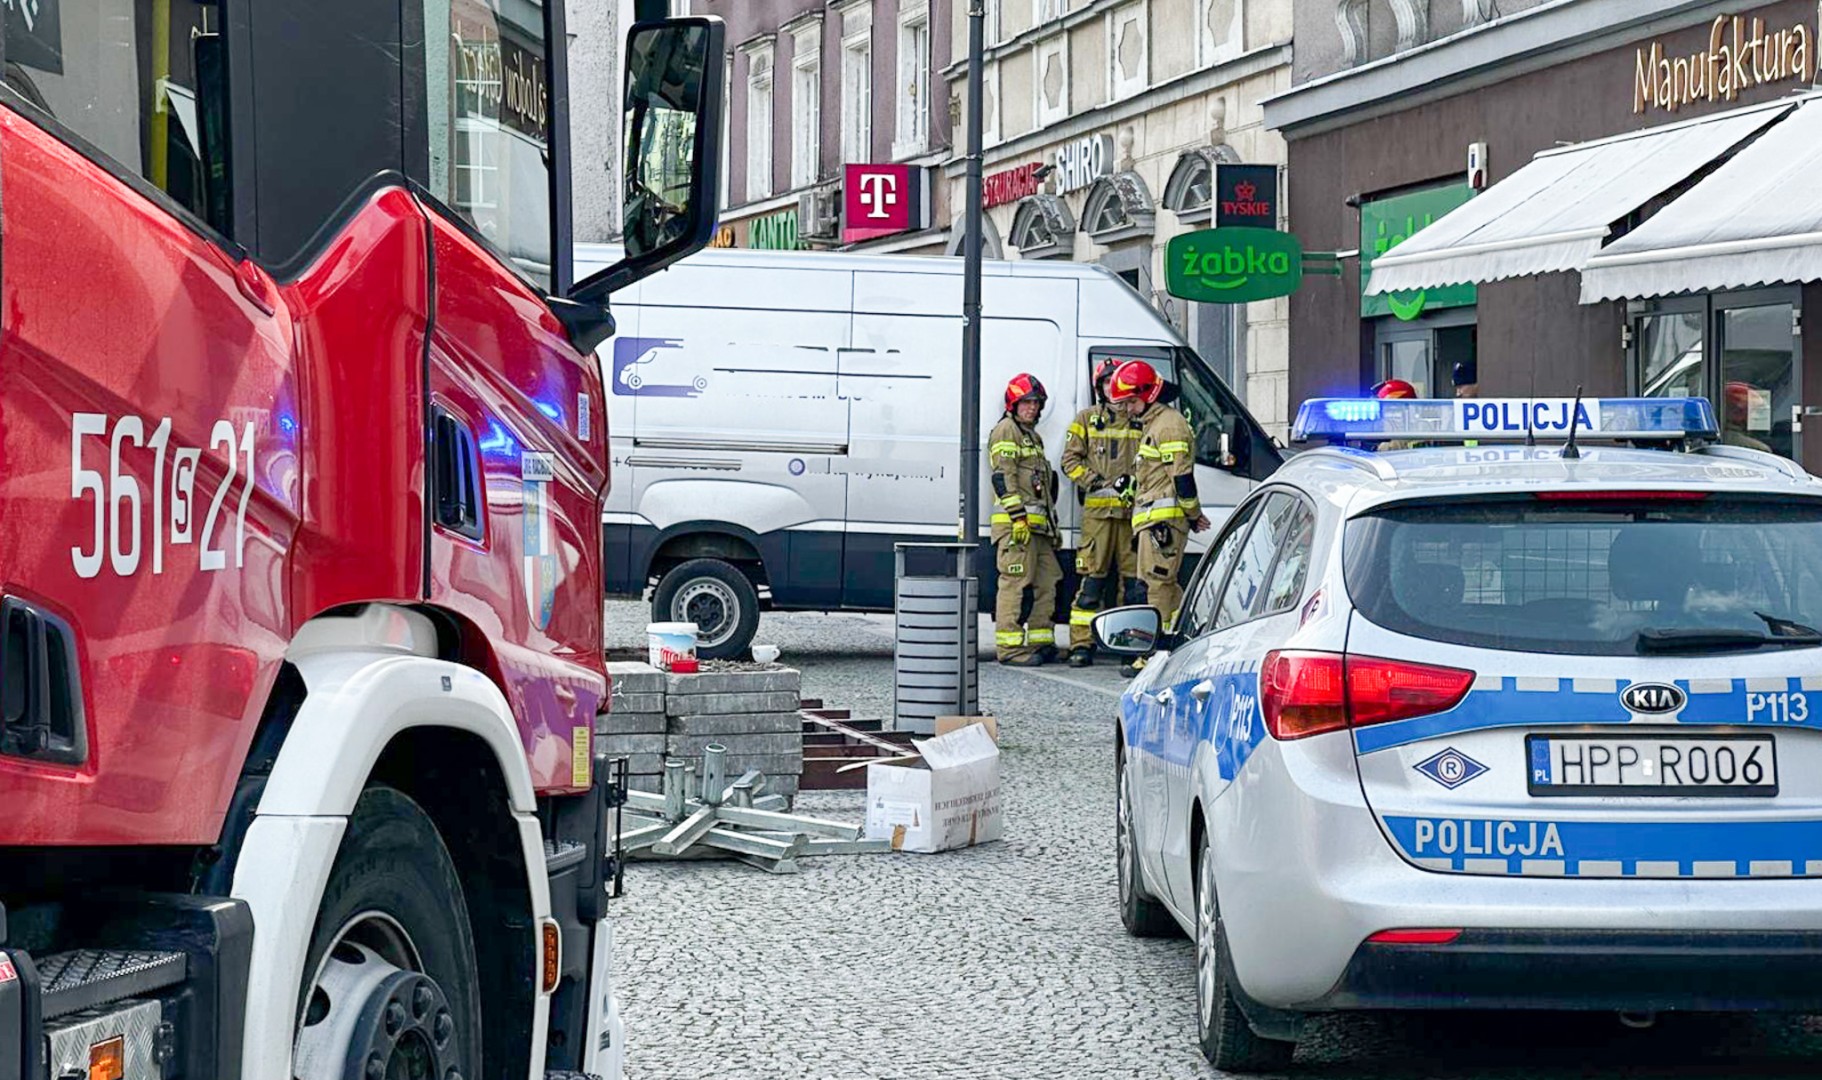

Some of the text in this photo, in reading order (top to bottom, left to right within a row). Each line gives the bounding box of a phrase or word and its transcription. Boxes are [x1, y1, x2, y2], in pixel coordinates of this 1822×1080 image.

[1634, 14, 1807, 113] Manufaktura
[1056, 133, 1104, 196] SHIRO
[1221, 202, 1270, 215] TYSKIE
[750, 210, 803, 250] KANTO
[1183, 245, 1289, 275] żabka
[1463, 402, 1593, 430] POLICJA
[71, 412, 172, 578] 561
[200, 419, 256, 572] 21
[1633, 690, 1676, 708] KIA
[1746, 692, 1809, 722] P113
[1445, 762, 1457, 774] R
[1534, 770, 1550, 782] PL
[1561, 745, 1765, 784] HPP R006
[1416, 819, 1565, 856] POLICJA
